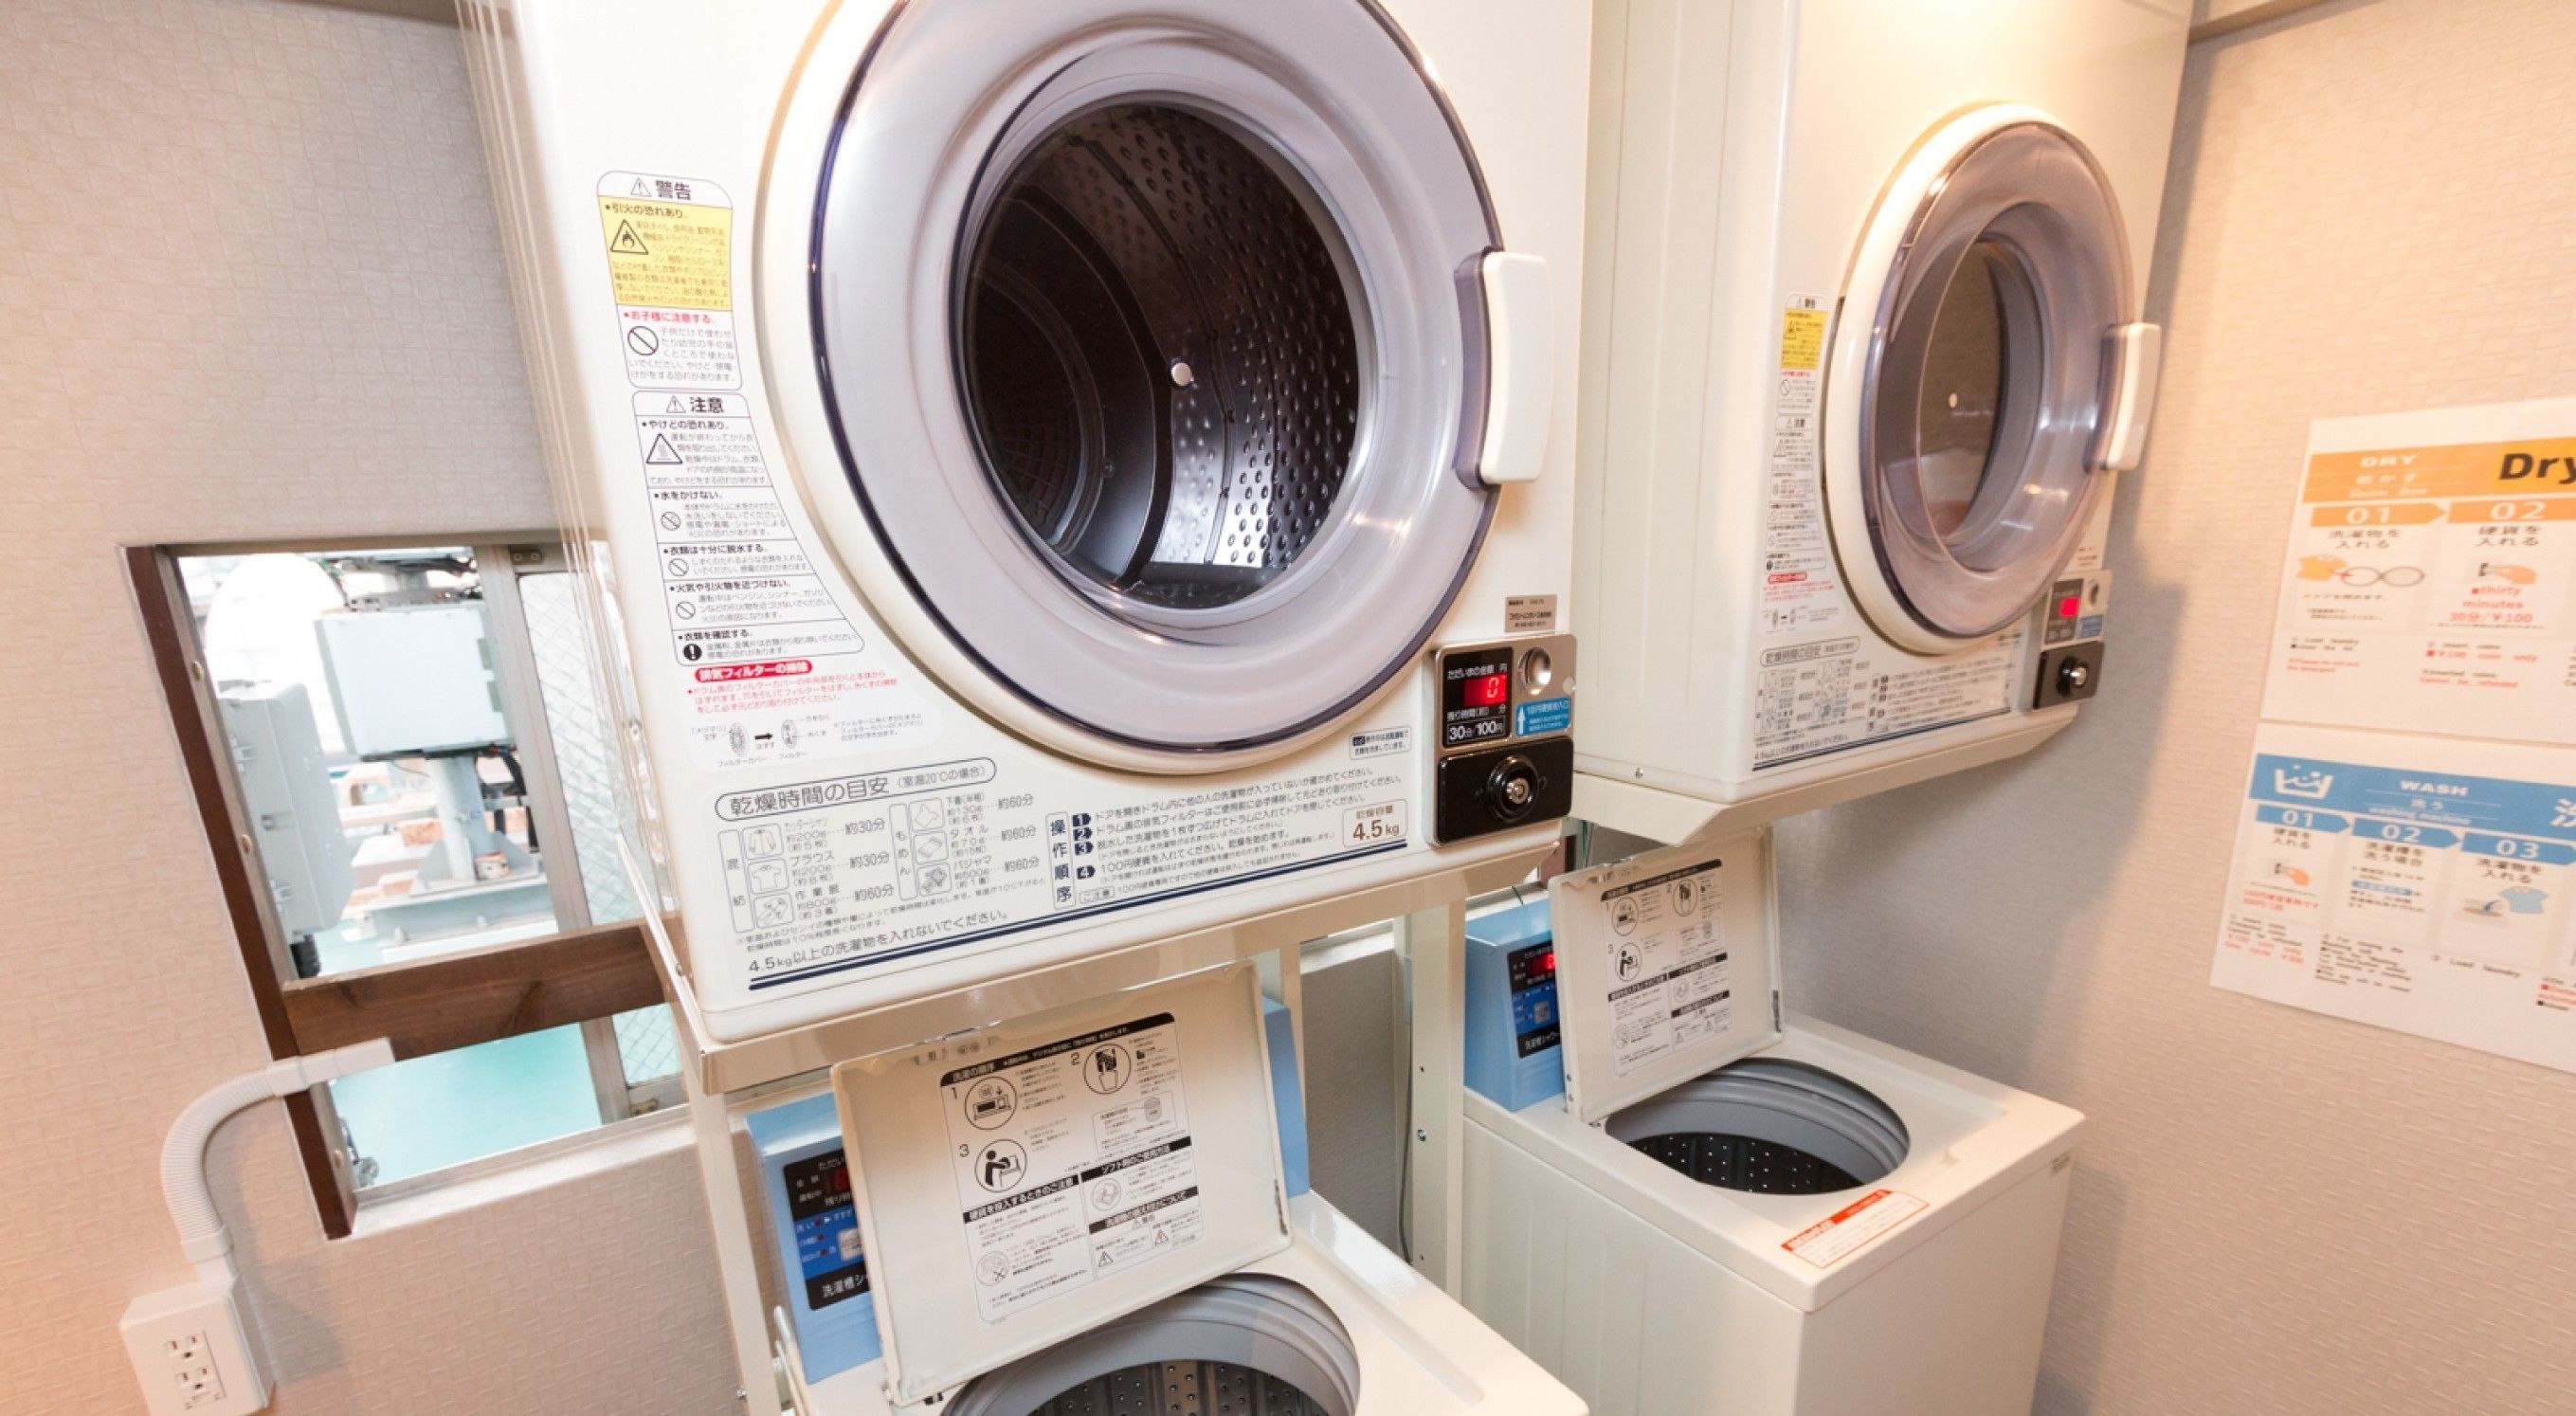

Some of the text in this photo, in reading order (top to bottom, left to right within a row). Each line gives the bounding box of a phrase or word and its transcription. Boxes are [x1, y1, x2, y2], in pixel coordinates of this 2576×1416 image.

[656, 180, 691, 200] 警告
[690, 397, 724, 413] 注意
[2361, 455, 2417, 467] DRY
[2347, 507, 2390, 525] 01
[2490, 501, 2547, 520] 02
[2336, 539, 2390, 549] 入れる
[2476, 536, 2539, 547] 入れる
[1487, 678, 1498, 699] 0
[731, 777, 889, 815] 乾燥時間の目安
[2400, 780, 2469, 796] WASH
[2282, 810, 2314, 827] 01
[2382, 825, 2422, 843] 02
[2495, 839, 2539, 859] 03
[1071, 1052, 1081, 1065] 2
[951, 1087, 957, 1099] 1
[959, 1144, 971, 1157] 3
